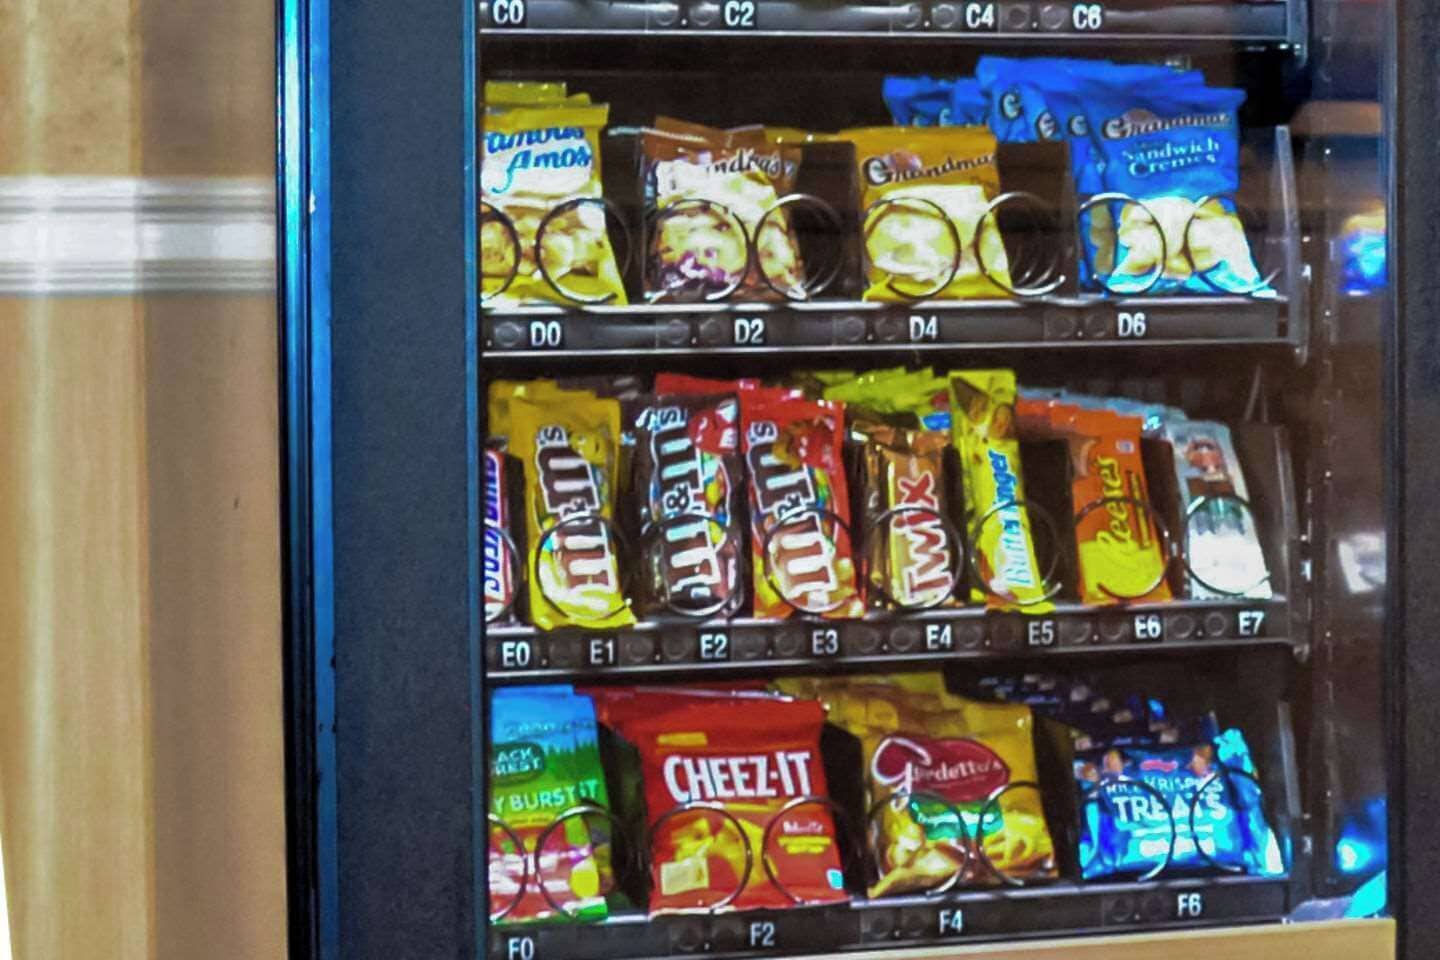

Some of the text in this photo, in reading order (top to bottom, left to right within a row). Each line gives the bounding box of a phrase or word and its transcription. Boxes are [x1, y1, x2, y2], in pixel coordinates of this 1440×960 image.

[493, 0, 523, 25] C0
[725, 2, 754, 26] C2
[966, 4, 994, 28] C4
[1073, 4, 1101, 29] C6
[1122, 137, 1220, 161] Sandwich
[491, 146, 593, 194] Amos
[531, 322, 561, 346] D0
[735, 319, 764, 344] D2
[910, 316, 938, 339] D4
[1118, 313, 1146, 337] D6
[1029, 621, 1053, 645] E5
[1135, 617, 1160, 638] E6
[1239, 612, 1264, 635] E7
[701, 635, 728, 658] E2
[812, 630, 838, 654] E3
[927, 625, 951, 649] E4
[503, 642, 530, 666] E0
[590, 640, 613, 664] E1
[663, 751, 811, 804] CHEEZ-IT
[510, 785, 576, 812] BURST
[1178, 894, 1201, 917] F6
[939, 910, 963, 934] F4
[751, 923, 774, 946] F2
[509, 938, 534, 960] F0
